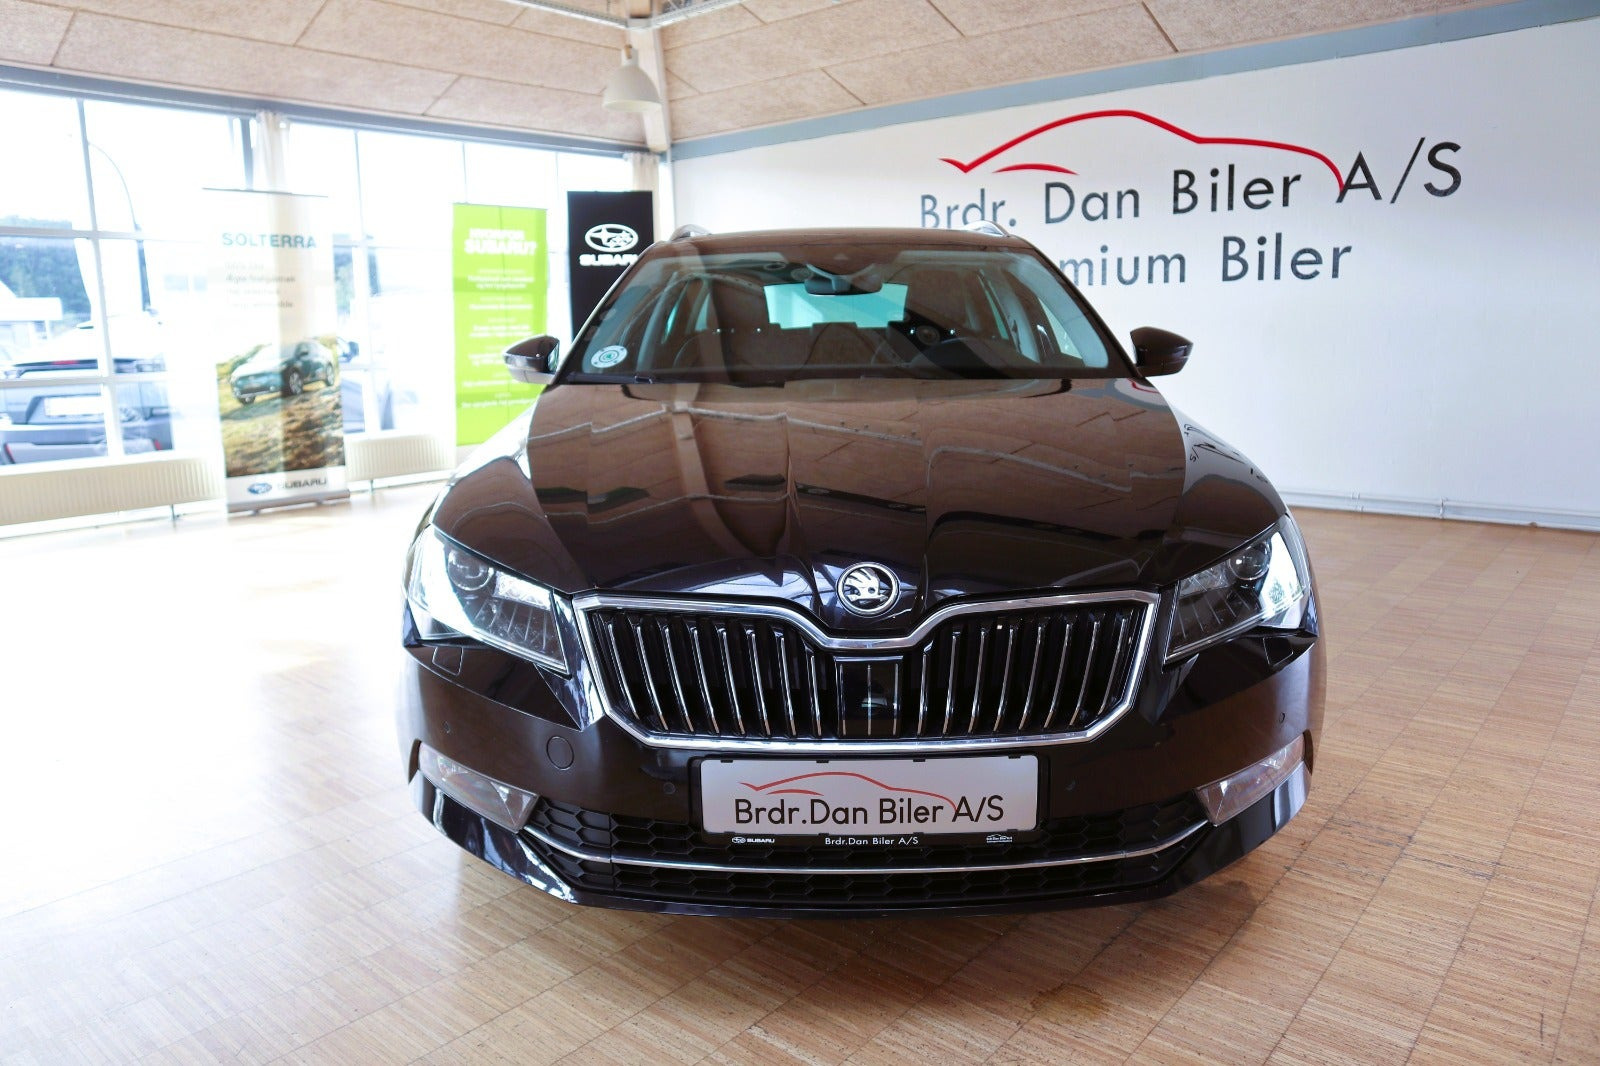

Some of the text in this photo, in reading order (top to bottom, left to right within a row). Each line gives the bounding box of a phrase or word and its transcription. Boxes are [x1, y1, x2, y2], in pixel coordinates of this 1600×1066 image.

[920, 136, 1463, 230] Brdr. Dan Biler A/S
[221, 231, 317, 249] SOLTERRA
[579, 253, 640, 267] SUBAR
[1058, 232, 1353, 287] mium Biler
[879, 797, 945, 825] Biler
[951, 794, 1005, 823] A/S
[746, 837, 776, 845] SUBARU
[872, 836, 895, 846] Biler
[898, 835, 919, 846] A/S
